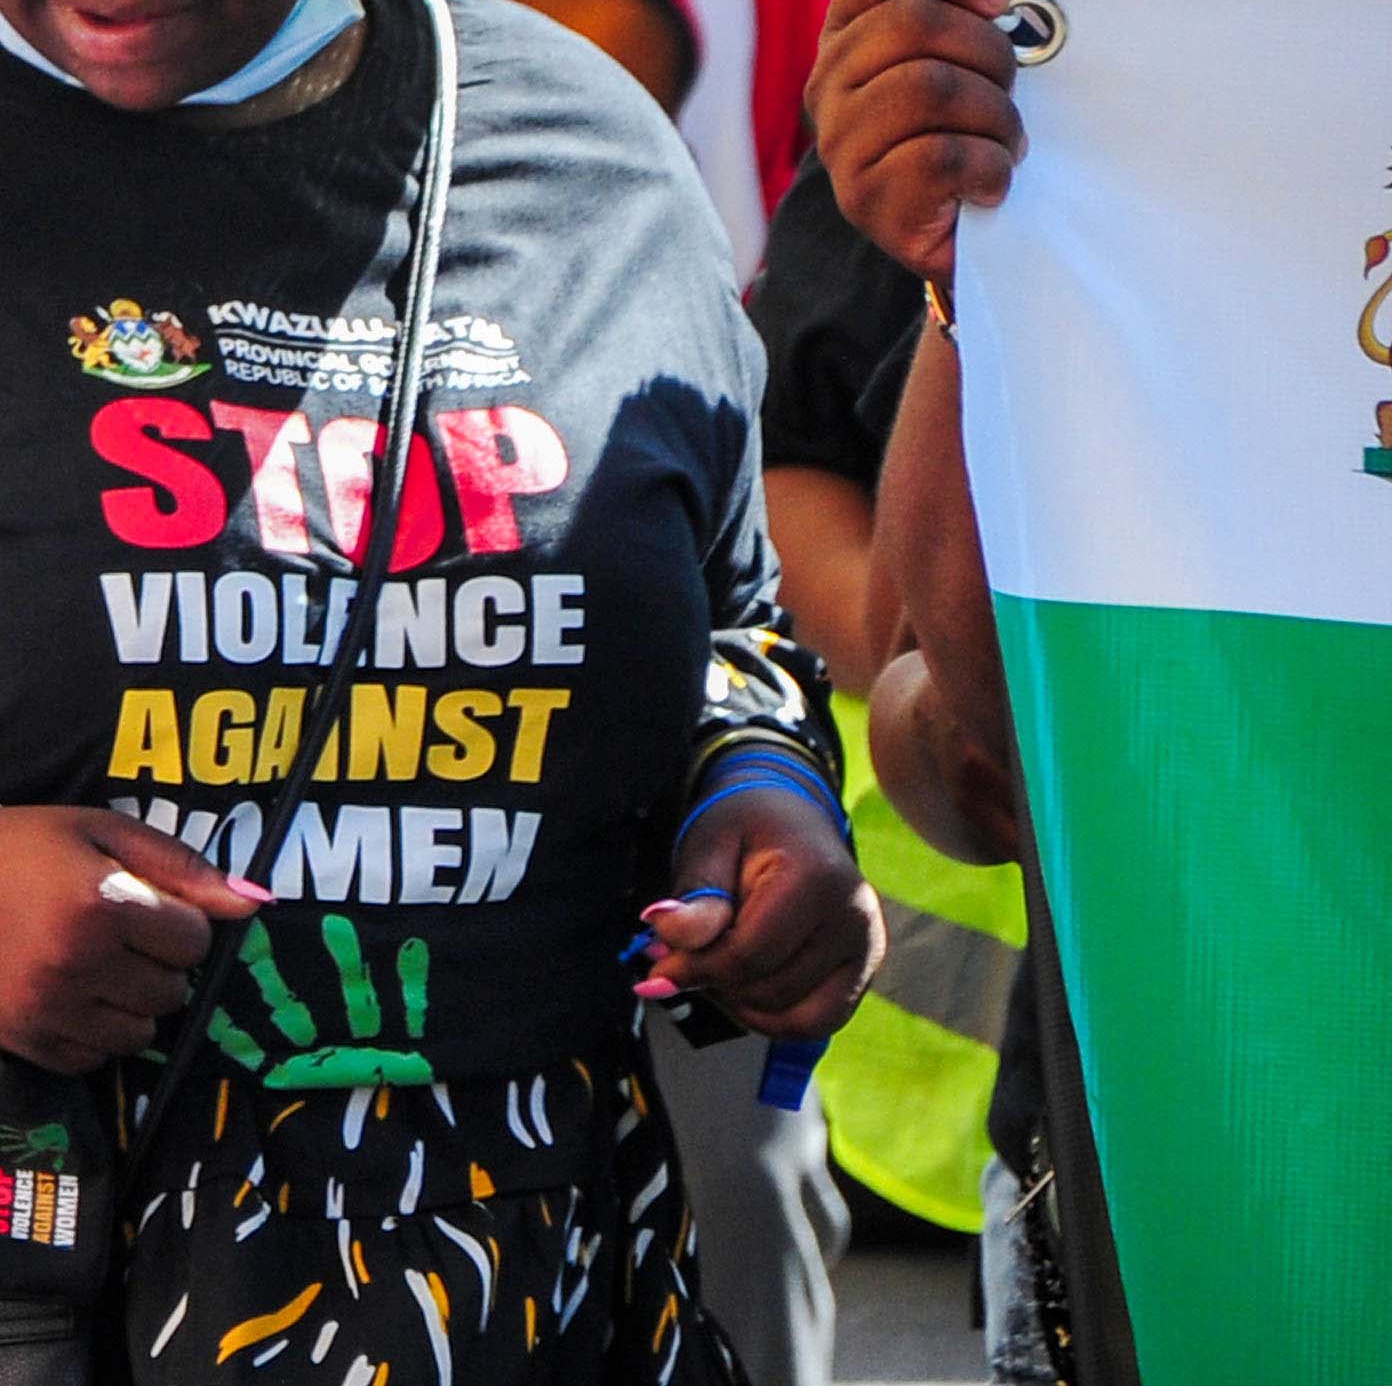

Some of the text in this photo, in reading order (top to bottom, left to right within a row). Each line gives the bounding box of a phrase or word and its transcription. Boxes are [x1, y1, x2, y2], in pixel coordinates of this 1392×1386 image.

[218, 337, 359, 374] PROVINCIAL
[224, 358, 331, 392] REPUBLIC
[332, 370, 363, 396] OF
[445, 366, 532, 392] AFRICA
[90, 395, 571, 574] STOP
[100, 571, 586, 669] VIOLENCE
[53, 1174, 79, 1247] WOMEN
